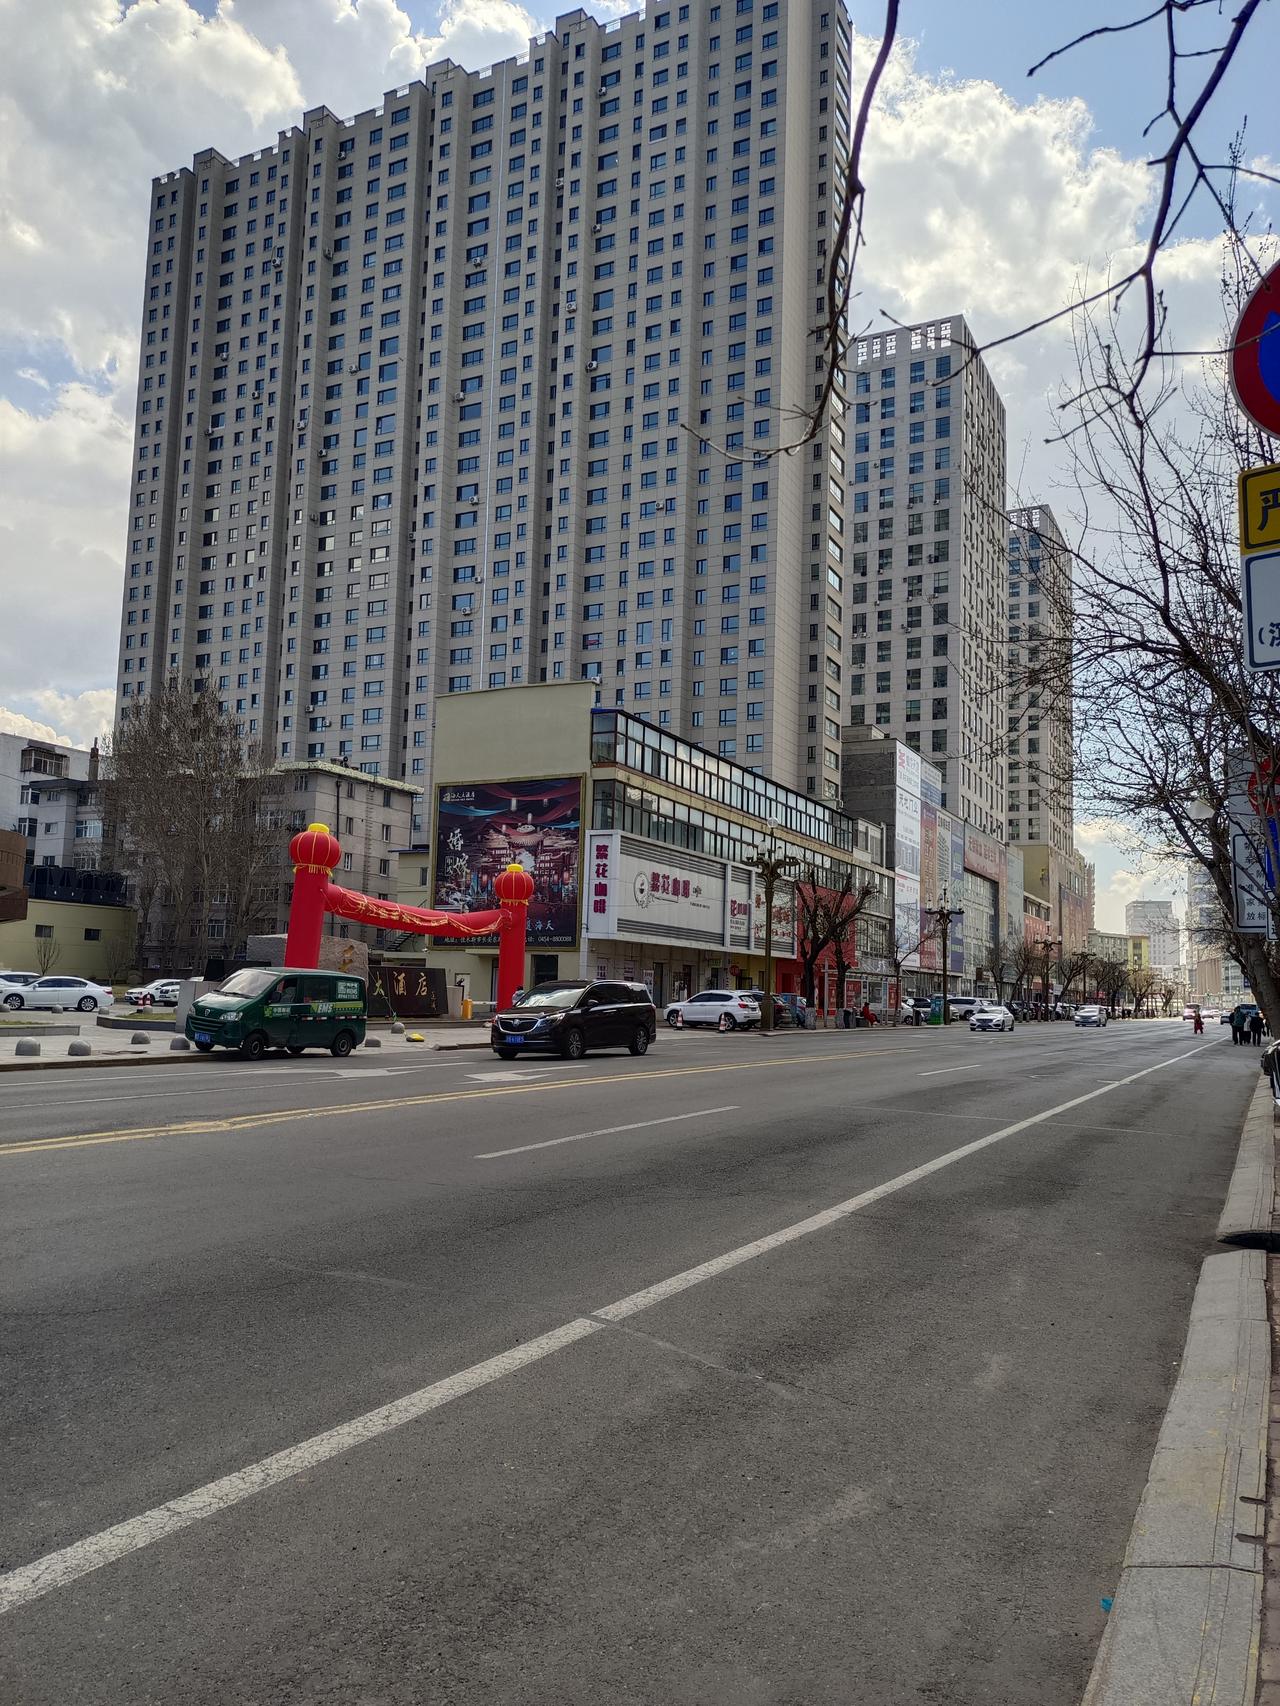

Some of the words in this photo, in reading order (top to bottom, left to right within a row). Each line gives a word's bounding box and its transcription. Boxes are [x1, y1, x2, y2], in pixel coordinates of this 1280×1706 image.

[373, 971, 428, 996] 大酒店
[318, 1002, 333, 1014] EMS
